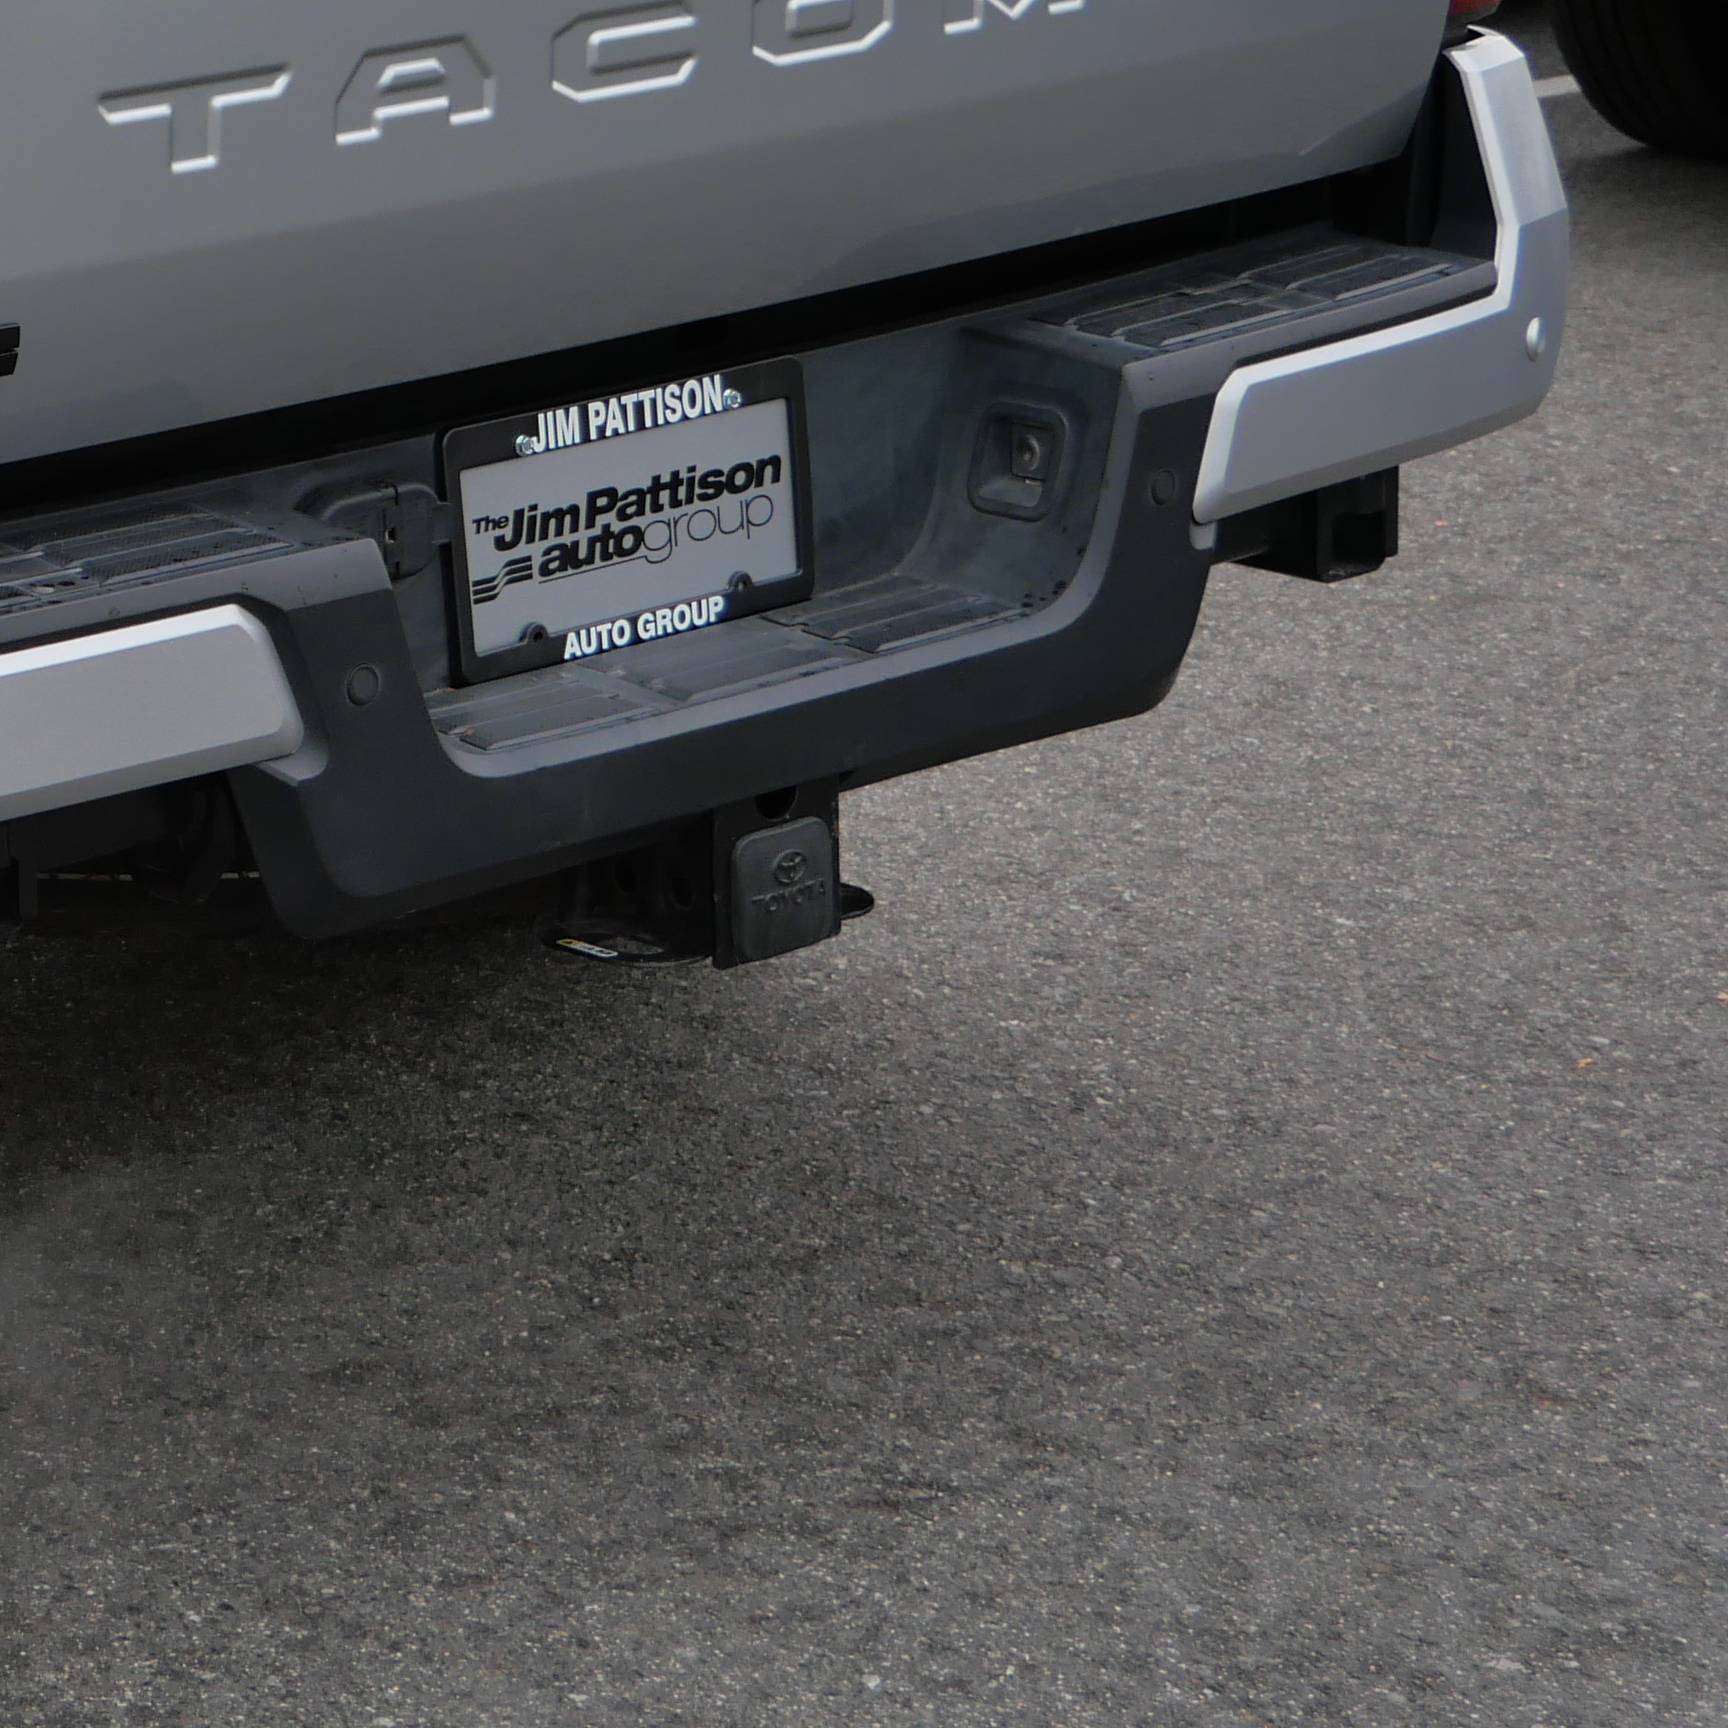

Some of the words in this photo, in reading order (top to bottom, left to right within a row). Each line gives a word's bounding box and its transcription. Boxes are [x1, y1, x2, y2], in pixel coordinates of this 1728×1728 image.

[532, 405, 580, 454] JIM
[587, 374, 724, 441] PATTISON
[472, 513, 509, 535] The
[564, 619, 631, 661] AUTO
[637, 594, 726, 640] GROUP
